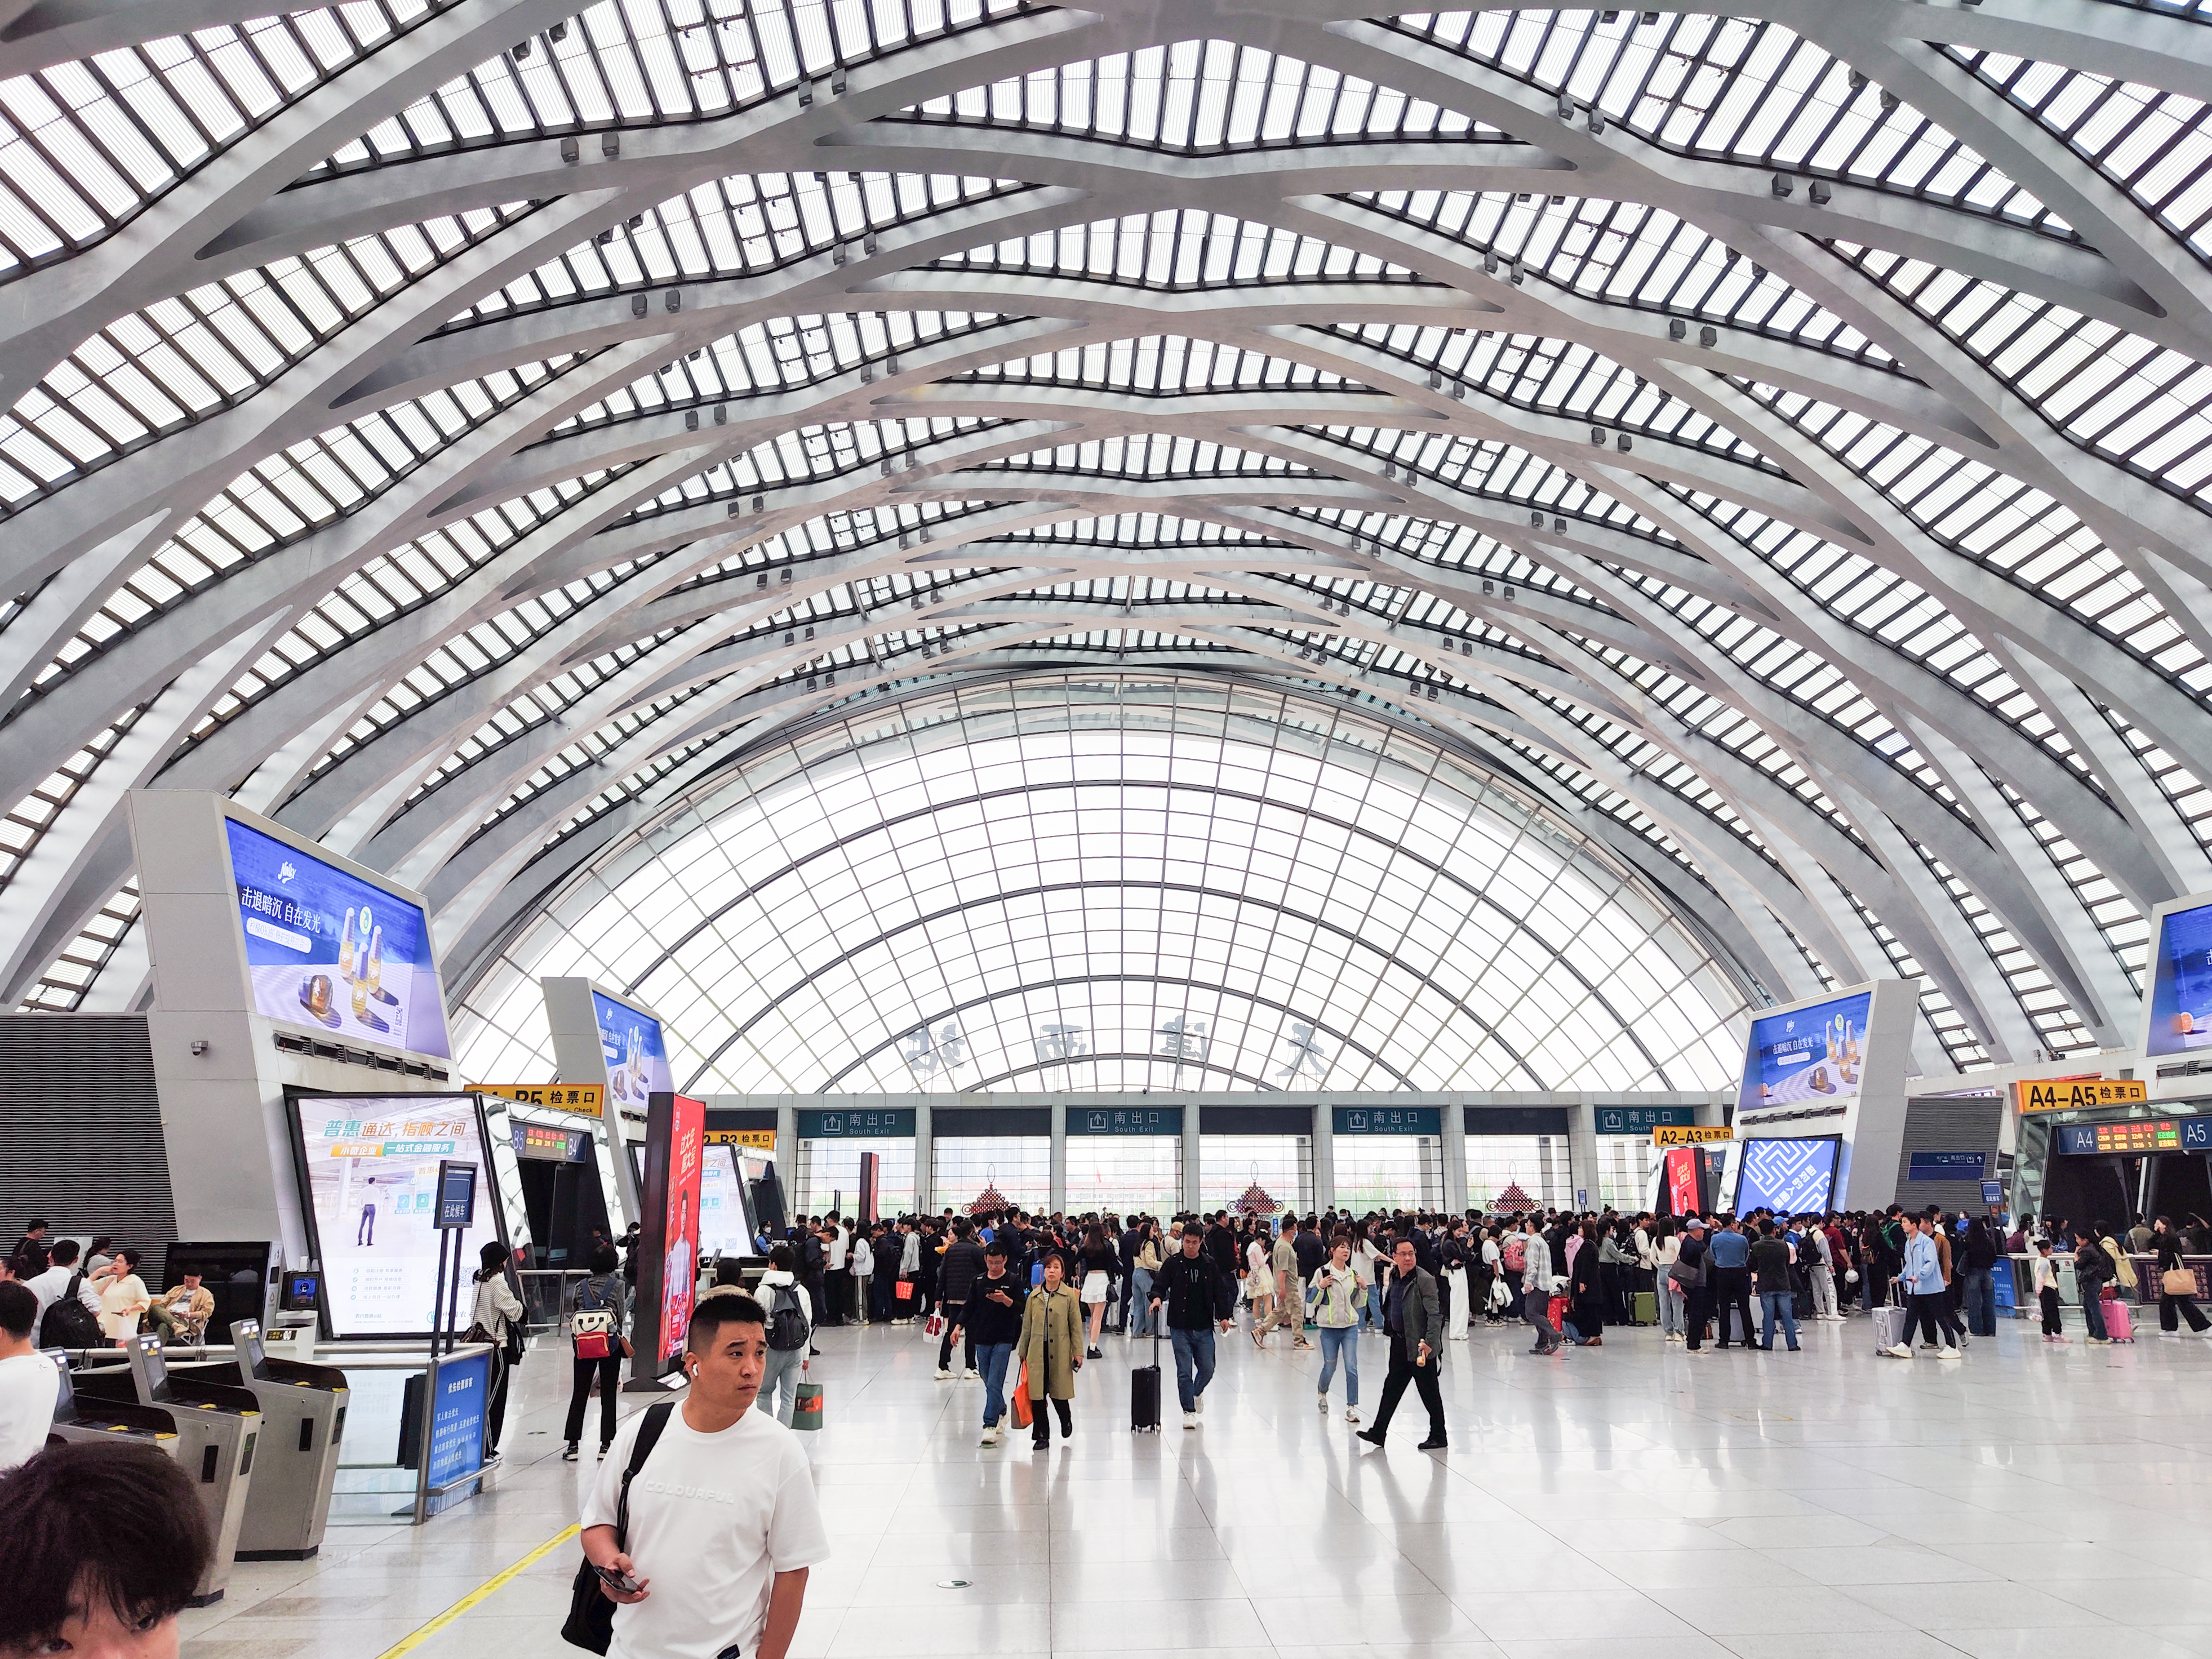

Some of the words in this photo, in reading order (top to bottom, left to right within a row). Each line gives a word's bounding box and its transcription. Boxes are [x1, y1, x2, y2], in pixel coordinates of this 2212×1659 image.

[241, 886, 283, 919] 击退暗沉
[285, 903, 321, 933] 自在发光
[1773, 1042, 1793, 1055] 击退暗沉
[1793, 1037, 1814, 1051] 自在发光
[550, 1091, 594, 1104] 检票口
[2029, 1086, 2096, 1107] A4-A5
[2100, 1086, 2140, 1098] 检票口
[849, 1113, 895, 1126] 南出口
[1114, 1111, 1159, 1124] 南出口
[1373, 1111, 1418, 1123] 南出口
[1628, 1110, 1672, 1123] 南出口
[514, 1130, 525, 1150] B5
[742, 1134, 770, 1143] 检票口
[1660, 1130, 1702, 1145] A2-A3
[1704, 1131, 1730, 1139] 检票口
[2077, 1131, 2093, 1148] A4
[2187, 1124, 2206, 1142] A5
[340, 1146, 377, 1155] 小微企业
[387, 1144, 450, 1153] 一站式金融服务
[568, 1138, 578, 1155] B4
[1713, 1157, 1721, 1168] A3
[419, 1166, 440, 1175] 普惠e
[445, 1204, 465, 1218] 在此候车
[645, 1480, 735, 1505] COLOURFUL
